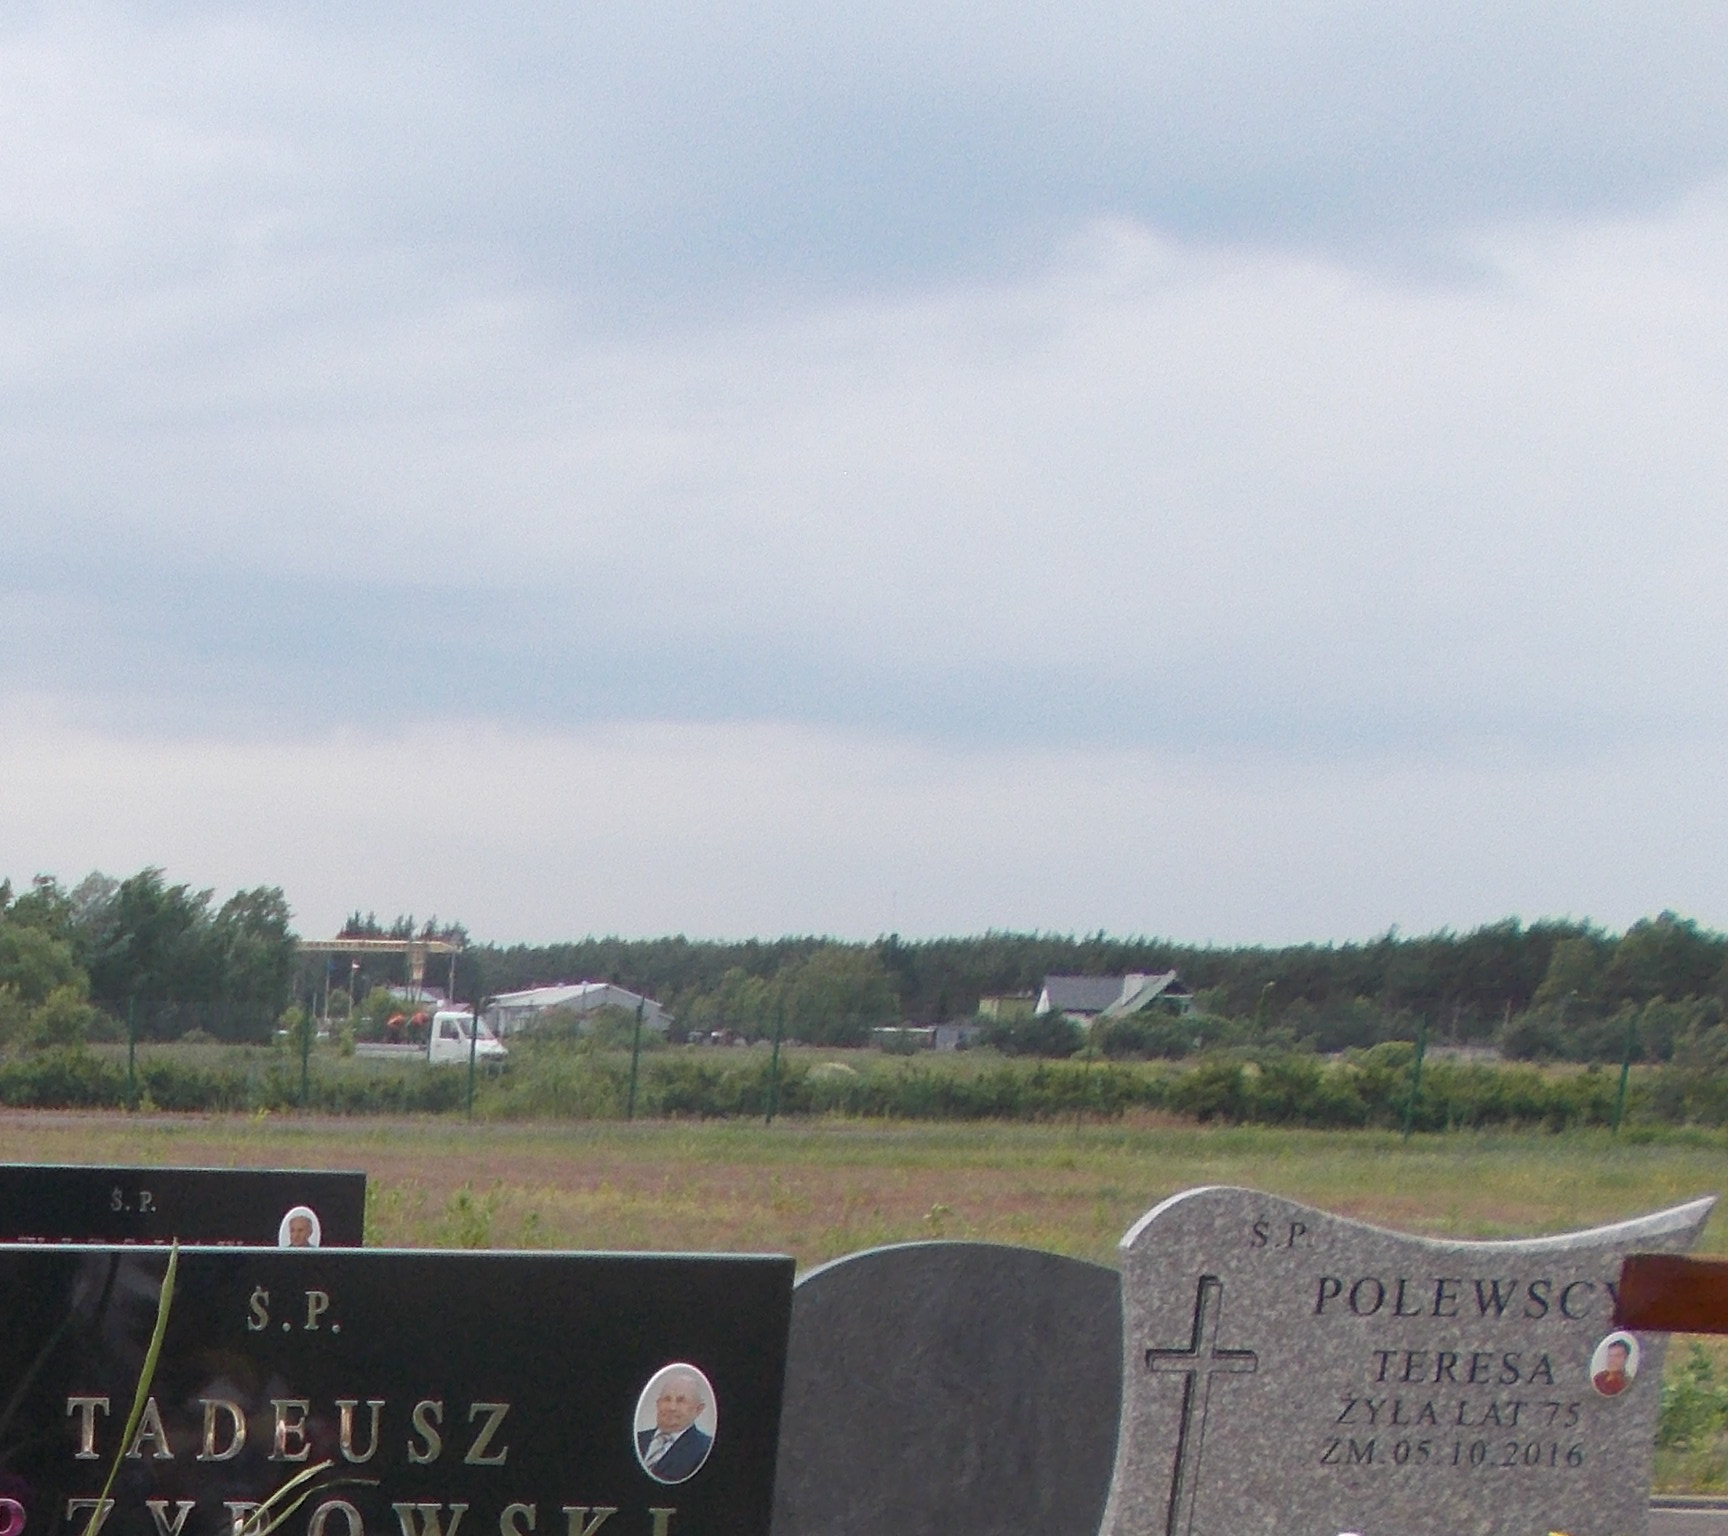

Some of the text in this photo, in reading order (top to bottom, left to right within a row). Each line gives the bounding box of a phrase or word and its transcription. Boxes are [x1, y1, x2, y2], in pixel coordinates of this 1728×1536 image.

[1373, 1349, 1555, 1386] TERESA
[66, 1396, 510, 1467] TADEUSZ
[1453, 1399, 1528, 1428] LAT
[1539, 1401, 1582, 1428] 75
